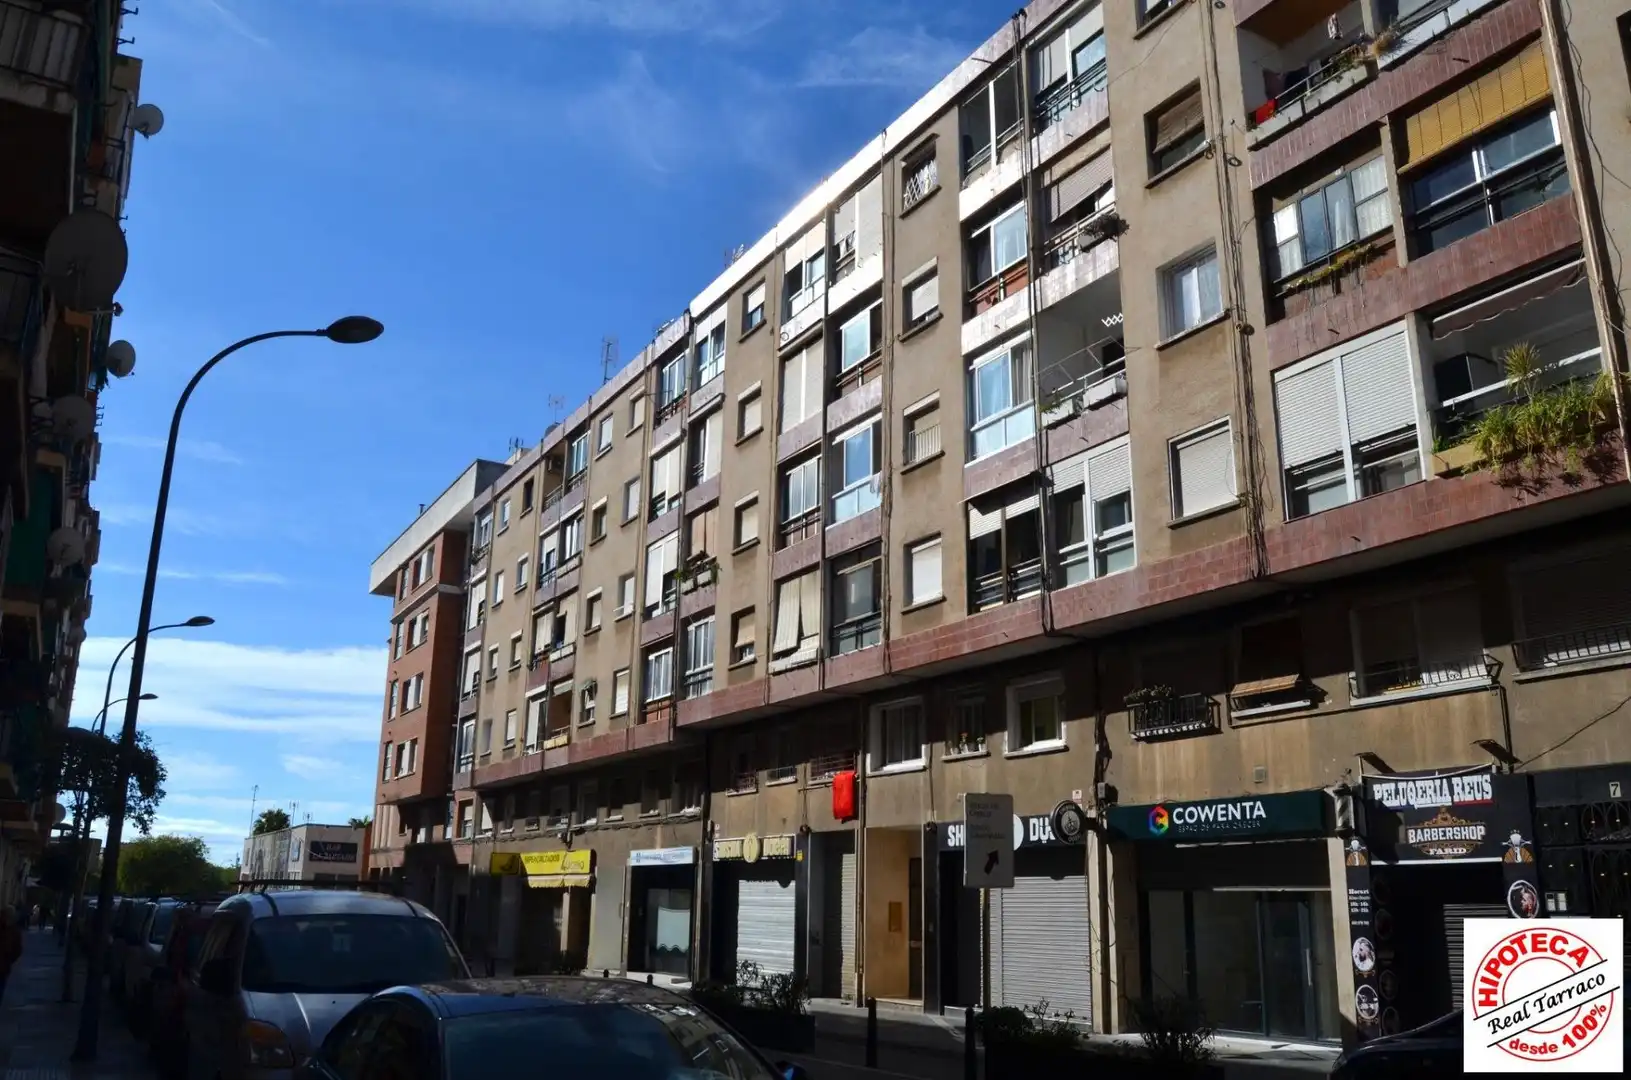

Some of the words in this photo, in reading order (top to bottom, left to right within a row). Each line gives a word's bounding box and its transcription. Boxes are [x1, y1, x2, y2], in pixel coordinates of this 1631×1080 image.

[1452, 775, 1493, 803] REUS
[1611, 784, 1619, 796] 7
[1173, 801, 1267, 824] COWENTA
[1407, 825, 1486, 844] BARBERSHOP
[1429, 847, 1467, 856] FARID
